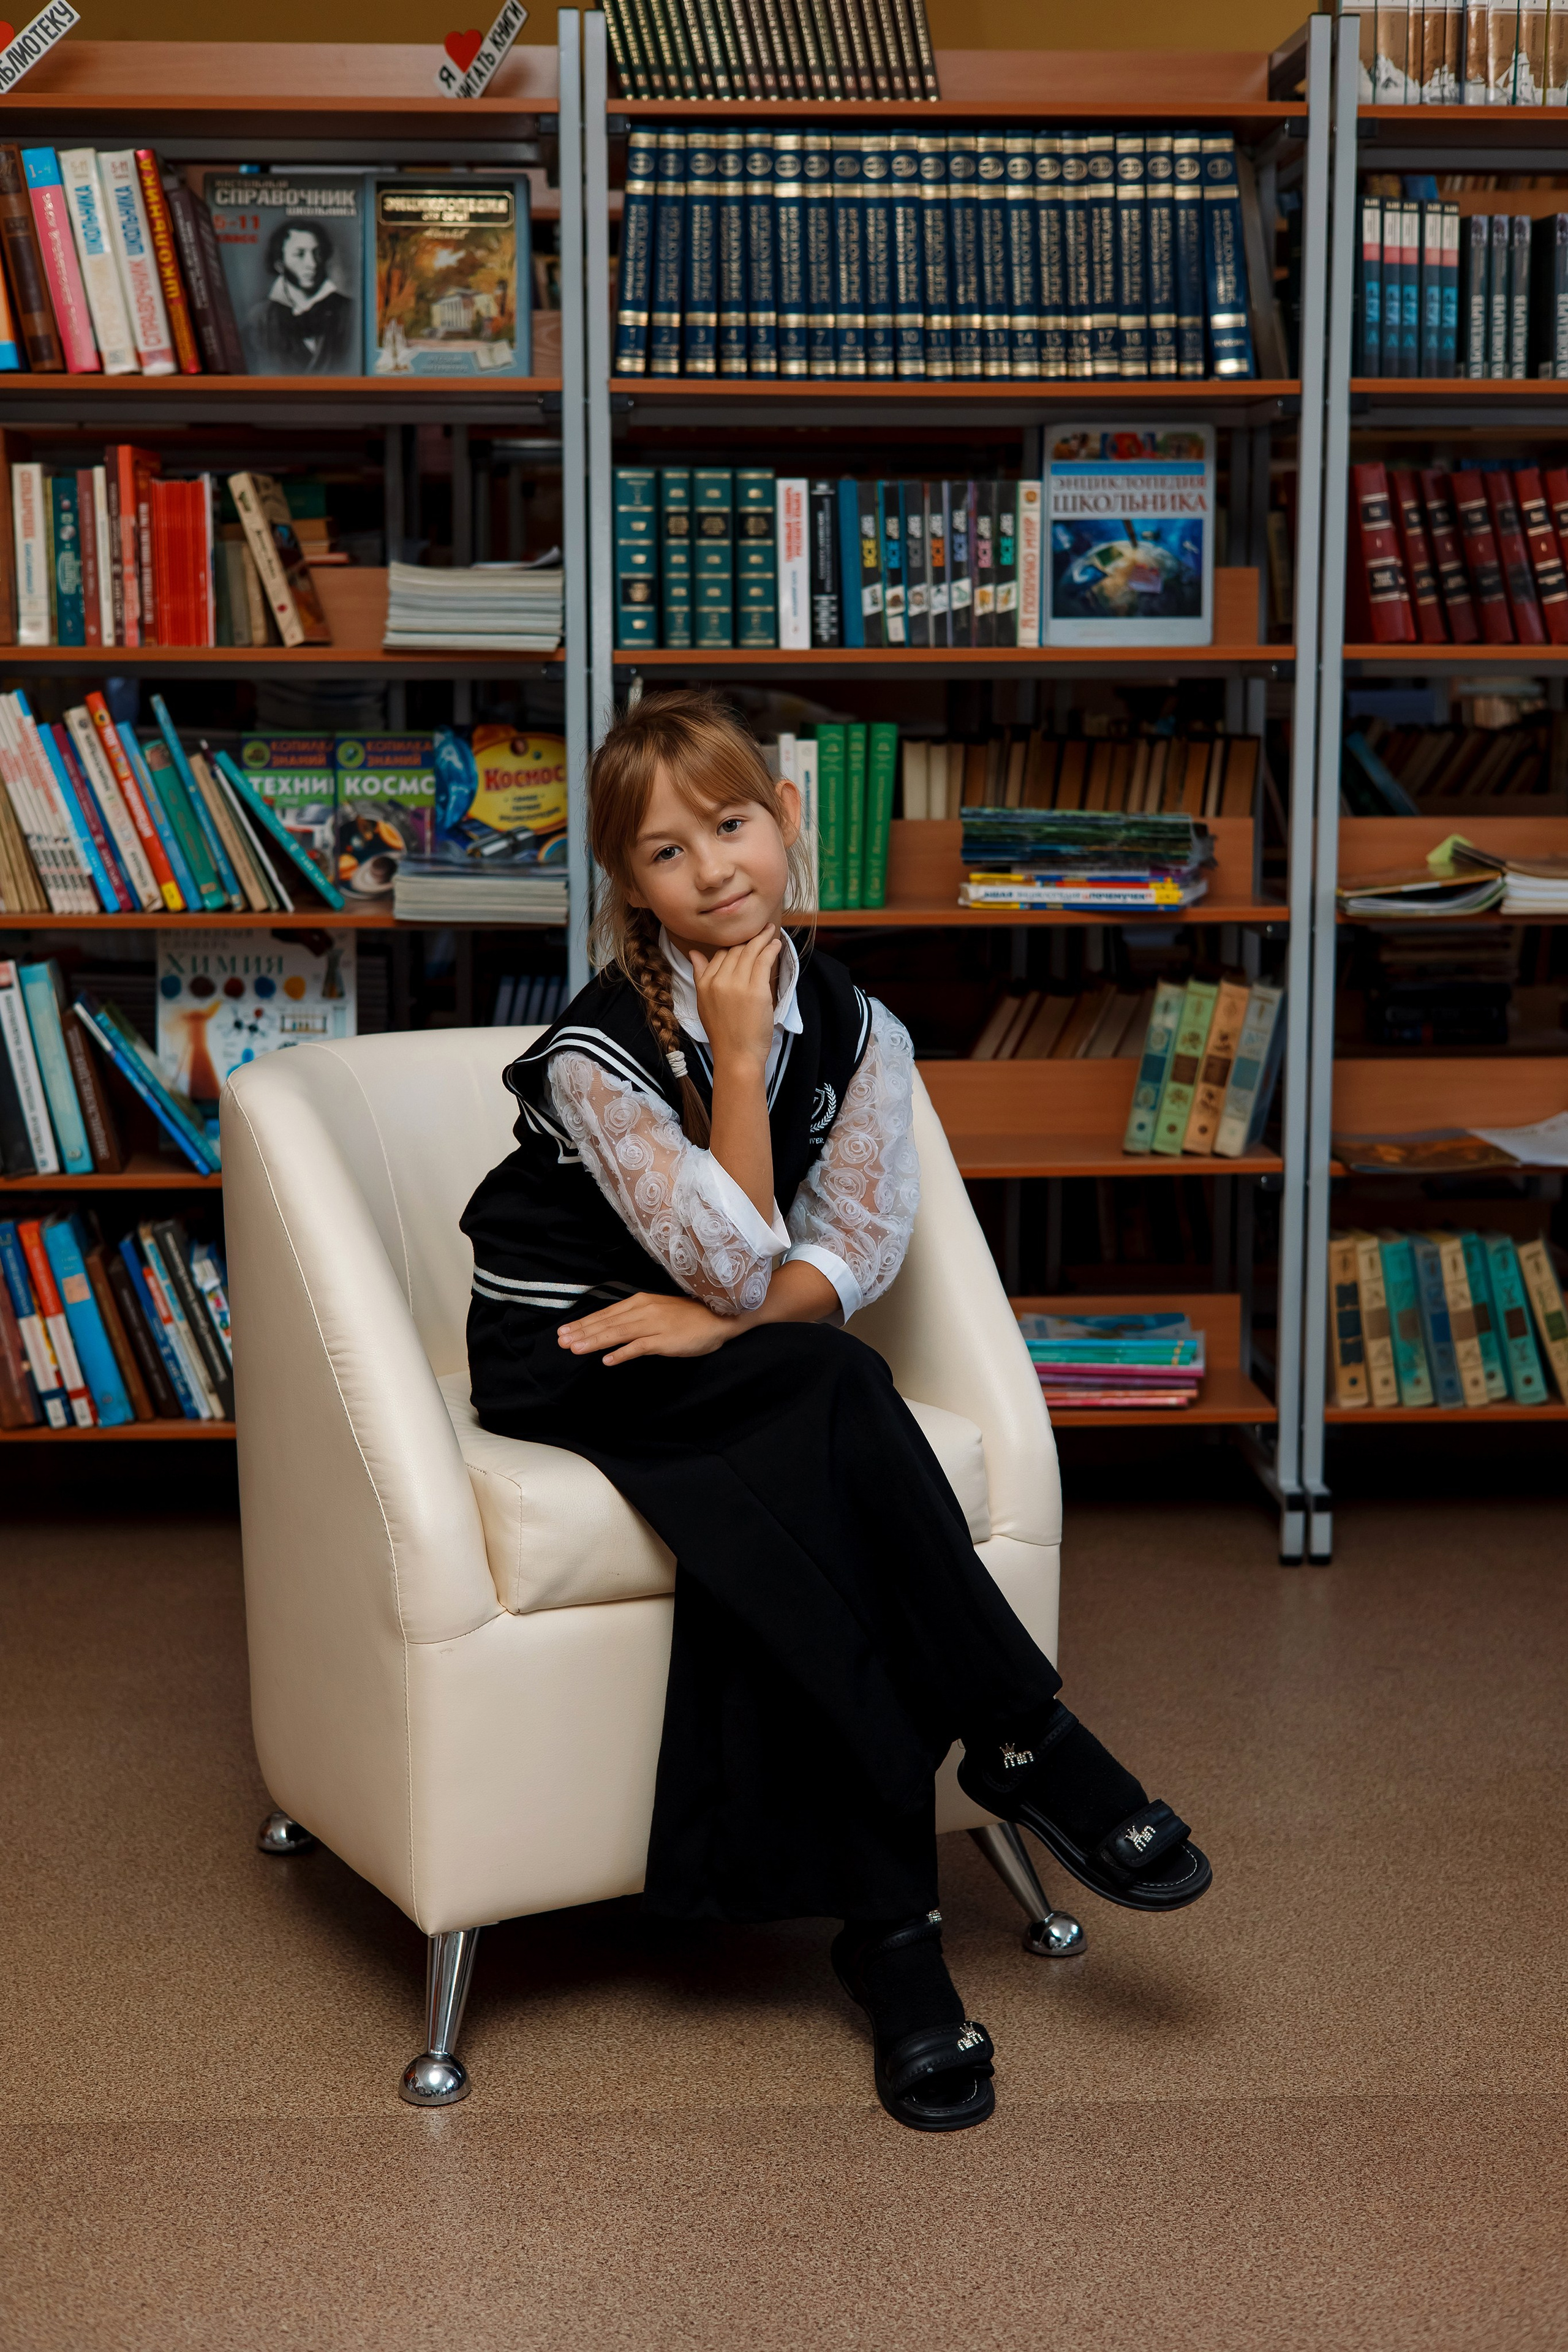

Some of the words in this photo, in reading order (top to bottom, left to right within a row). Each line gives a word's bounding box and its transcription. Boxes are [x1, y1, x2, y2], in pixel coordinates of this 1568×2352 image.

[489, 1, 522, 53] КНИГИ
[439, 65, 456, 89] Я
[215, 188, 356, 206] СПРАВОЧНИК
[140, 159, 179, 299] ШКОЛЬНИКА
[1052, 477, 1207, 491] ЭНЦИКЛОПЕДИЯ
[1053, 493, 1208, 513] ШКОЛЬНИКА
[953, 533, 968, 562] ВСЕ
[1022, 518, 1039, 549] МИР
[862, 539, 877, 568] ВСЕ
[887, 540, 900, 568] ВСЕ
[932, 538, 944, 567] ВСЕ
[978, 540, 992, 568] ВСЕ
[1001, 537, 1014, 565] ВСЕ
[1021, 551, 1036, 608] ПОЗНАЮ
[1021, 611, 1036, 629] Я
[345, 775, 435, 795] КОСМО
[165, 953, 283, 974] ХИМИЯ
